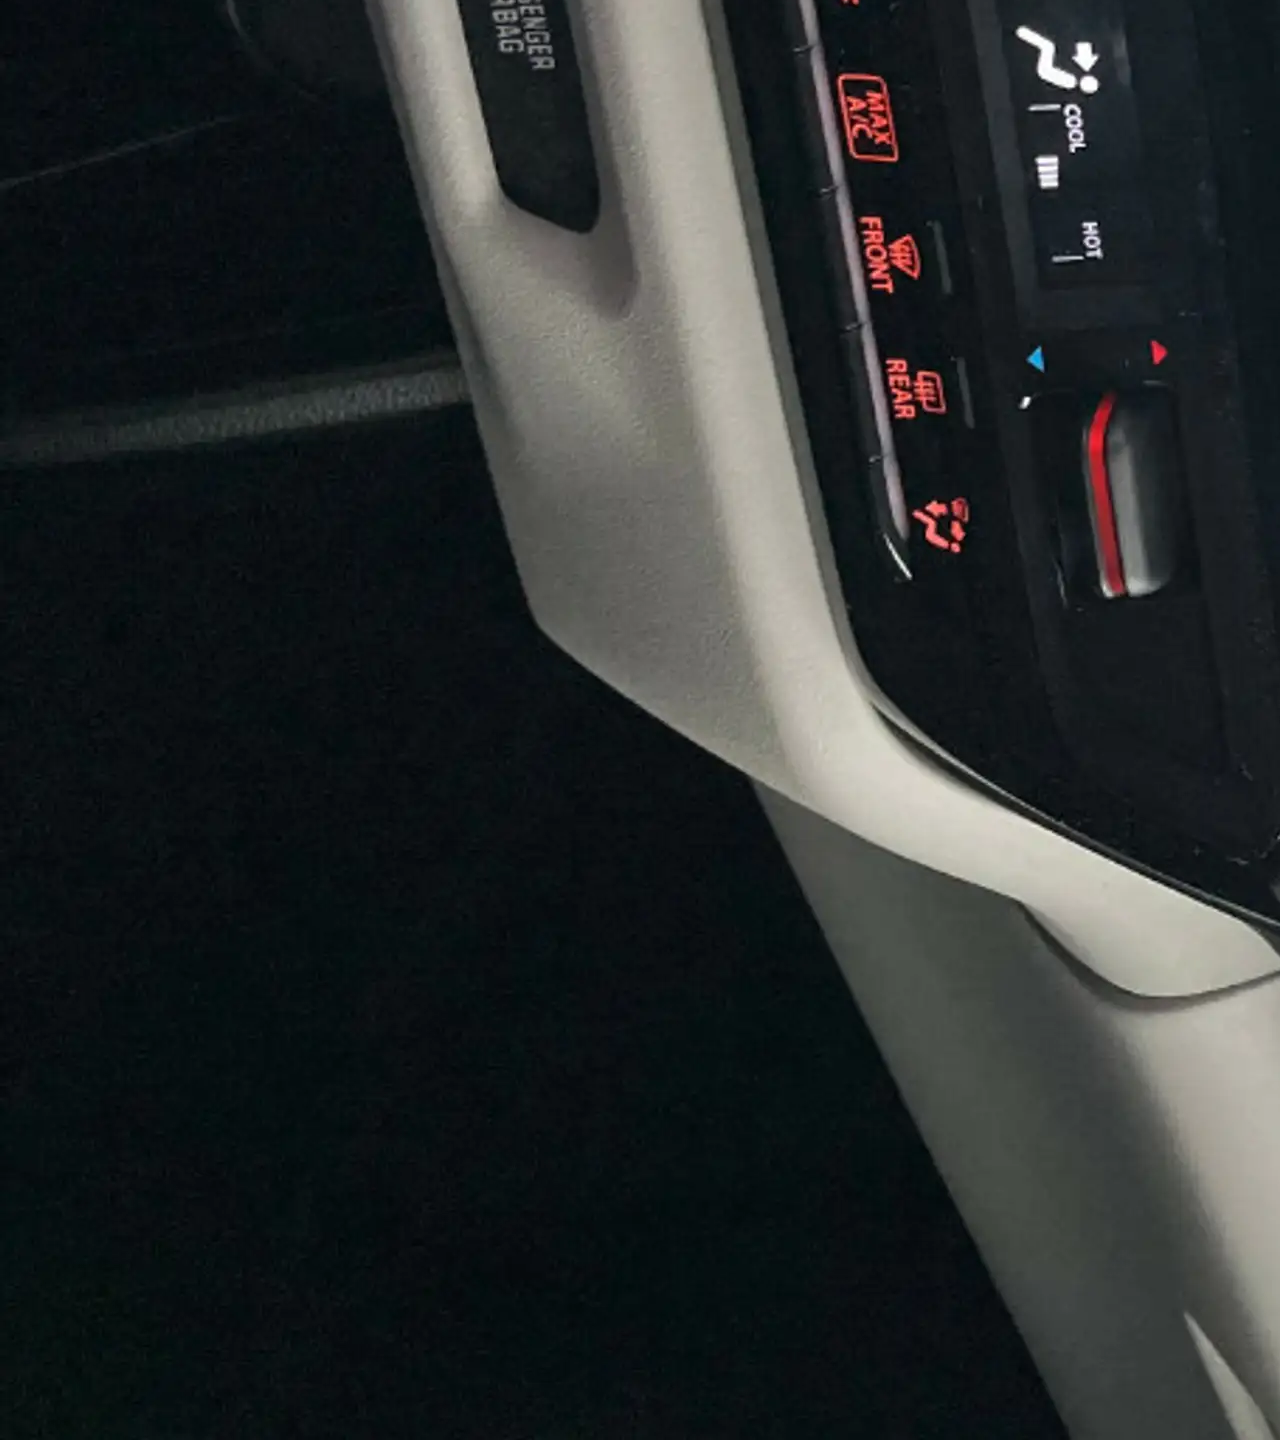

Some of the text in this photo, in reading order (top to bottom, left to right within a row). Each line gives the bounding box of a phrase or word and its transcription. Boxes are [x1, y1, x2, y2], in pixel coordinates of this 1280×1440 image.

[847, 95, 873, 140] A/C
[865, 91, 892, 145] MAX
[1063, 103, 1087, 153] COOL
[858, 216, 894, 294] FRONT
[1081, 221, 1104, 259] HOT
[885, 358, 916, 420] REAR
